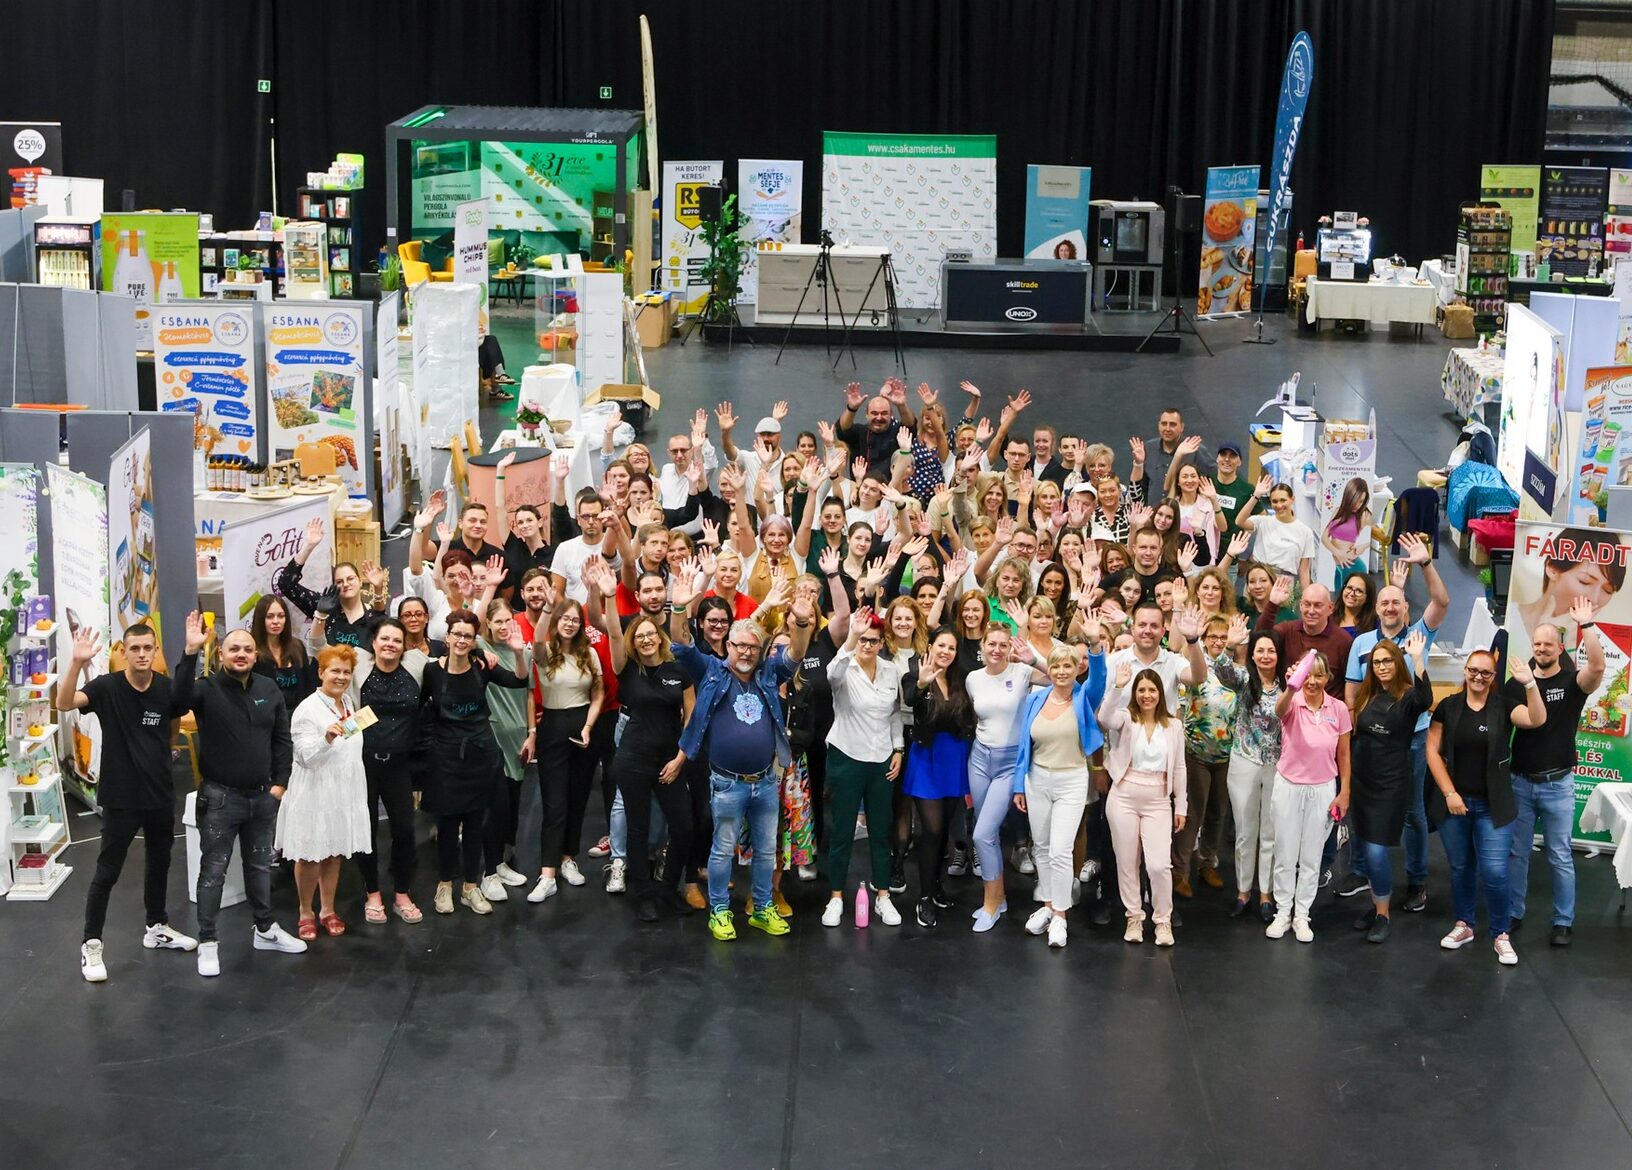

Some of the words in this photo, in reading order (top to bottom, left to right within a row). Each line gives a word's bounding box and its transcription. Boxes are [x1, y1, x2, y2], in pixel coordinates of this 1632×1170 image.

[18, 139, 42, 150] 25%
[867, 143, 956, 154] www.csakamentes.hu
[541, 152, 564, 176] 31
[758, 172, 784, 181] MENTES
[1267, 115, 1301, 252] CUKRÁSZDA
[424, 203, 447, 211] PERGOLA
[681, 231, 696, 248] 31
[460, 242, 487, 255] HUMMUS
[464, 252, 483, 263] CHIPS
[161, 317, 209, 327] ESBANA
[272, 316, 320, 326] ESBANA
[194, 519, 226, 534] NA
[255, 527, 304, 567] GoFit
[1525, 532, 1632, 567] FÁRADT
[803, 660, 820, 669] STAFF
[1546, 692, 1565, 702] STAFF
[1572, 765, 1622, 781] NOKKAL
